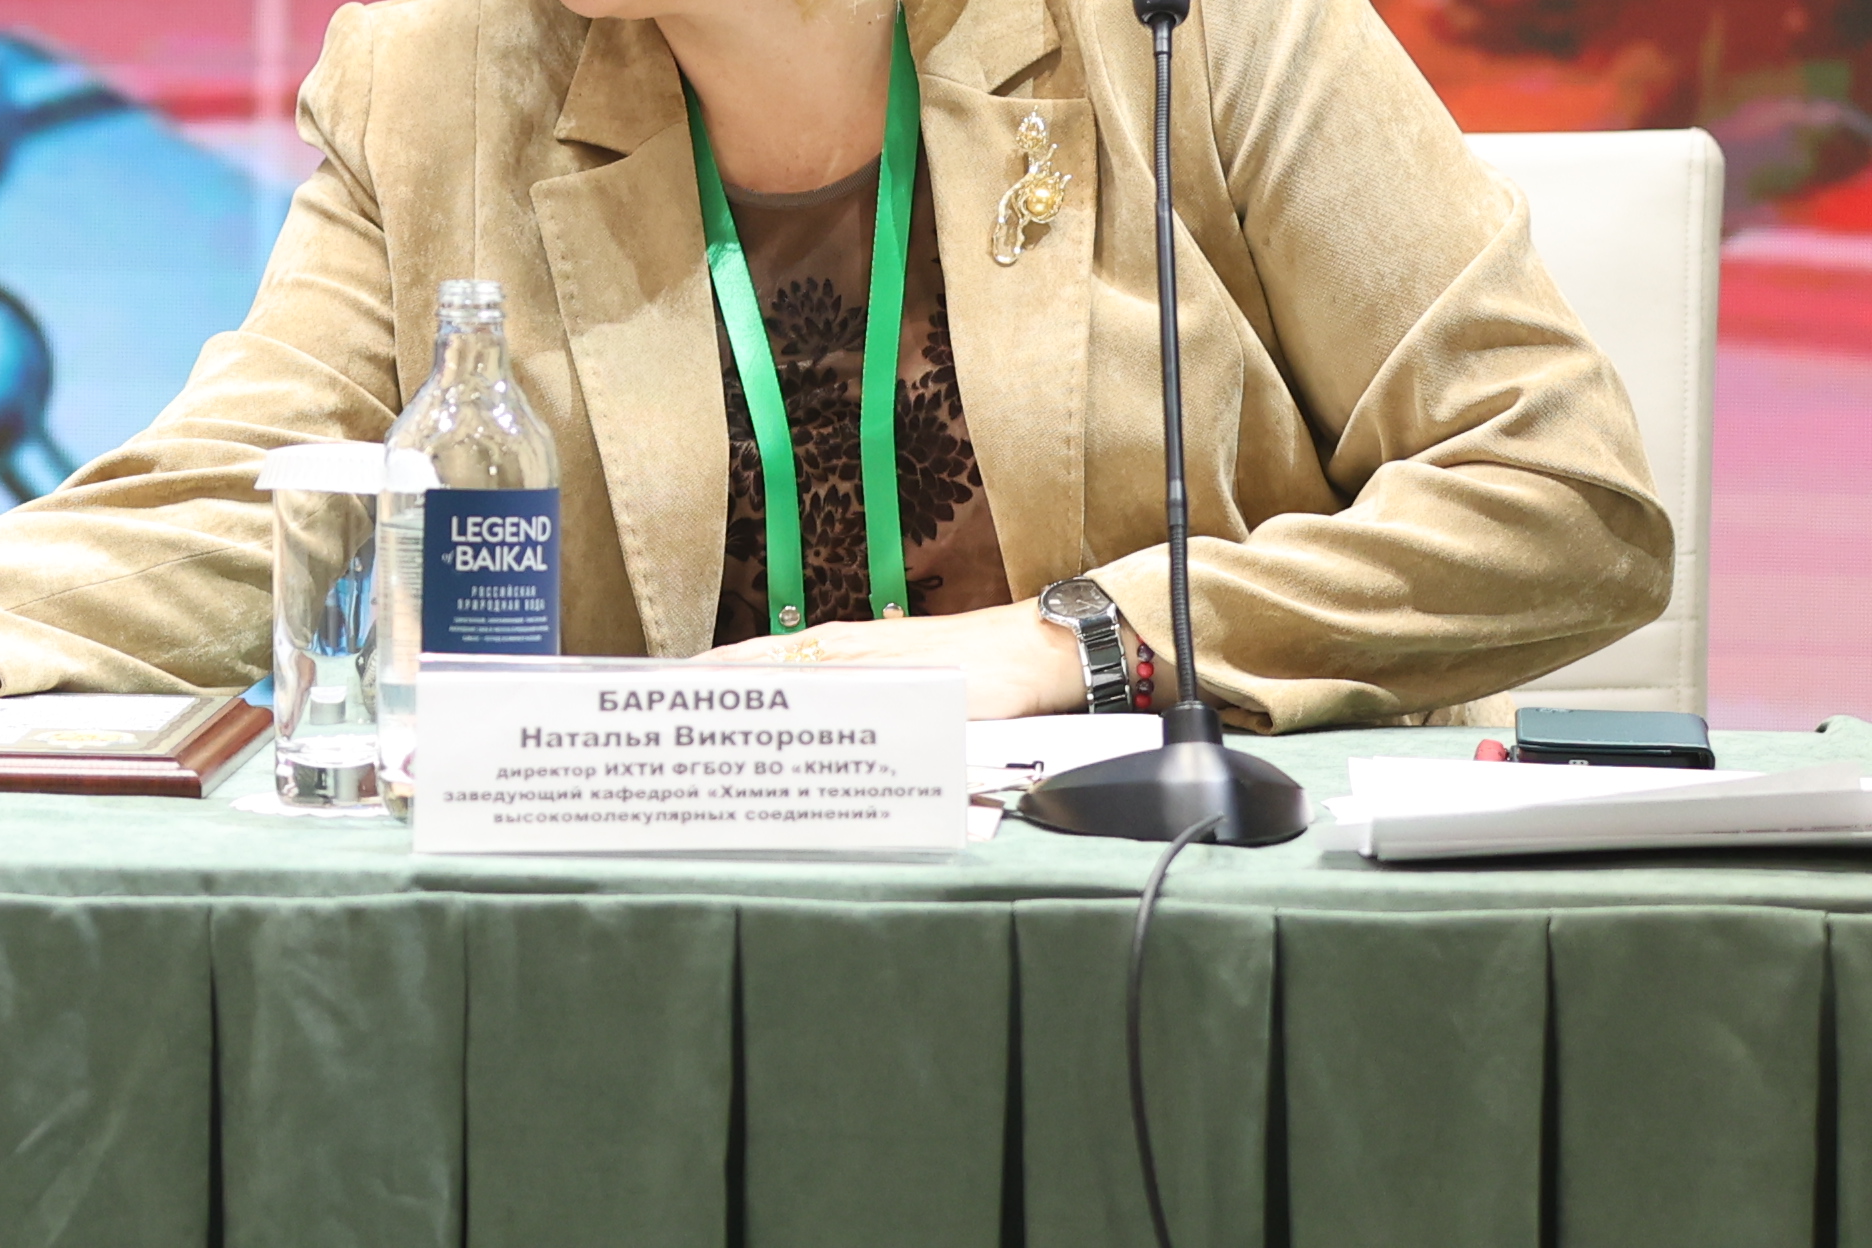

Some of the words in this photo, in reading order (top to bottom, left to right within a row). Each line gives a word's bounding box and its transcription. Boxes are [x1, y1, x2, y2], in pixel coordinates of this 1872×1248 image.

[451, 515, 552, 543] LEGEND
[455, 544, 549, 572] BAIKAL
[598, 689, 791, 713] БАРАНОВА
[519, 726, 661, 749] Наталья
[673, 724, 878, 751] Викторовна
[495, 765, 598, 780] директор
[604, 761, 665, 777] ИХТИ
[671, 760, 746, 777] ФГБОУ
[753, 760, 784, 776] ВО
[791, 759, 897, 778] «КНИТУ»,
[442, 785, 583, 804] заведующий
[590, 783, 699, 803] кафедрой
[707, 784, 790, 799] «Химия
[797, 786, 811, 798] и
[818, 785, 944, 799] технология
[493, 808, 738, 827] высокомолекулярных
[744, 804, 892, 823] соединений»
